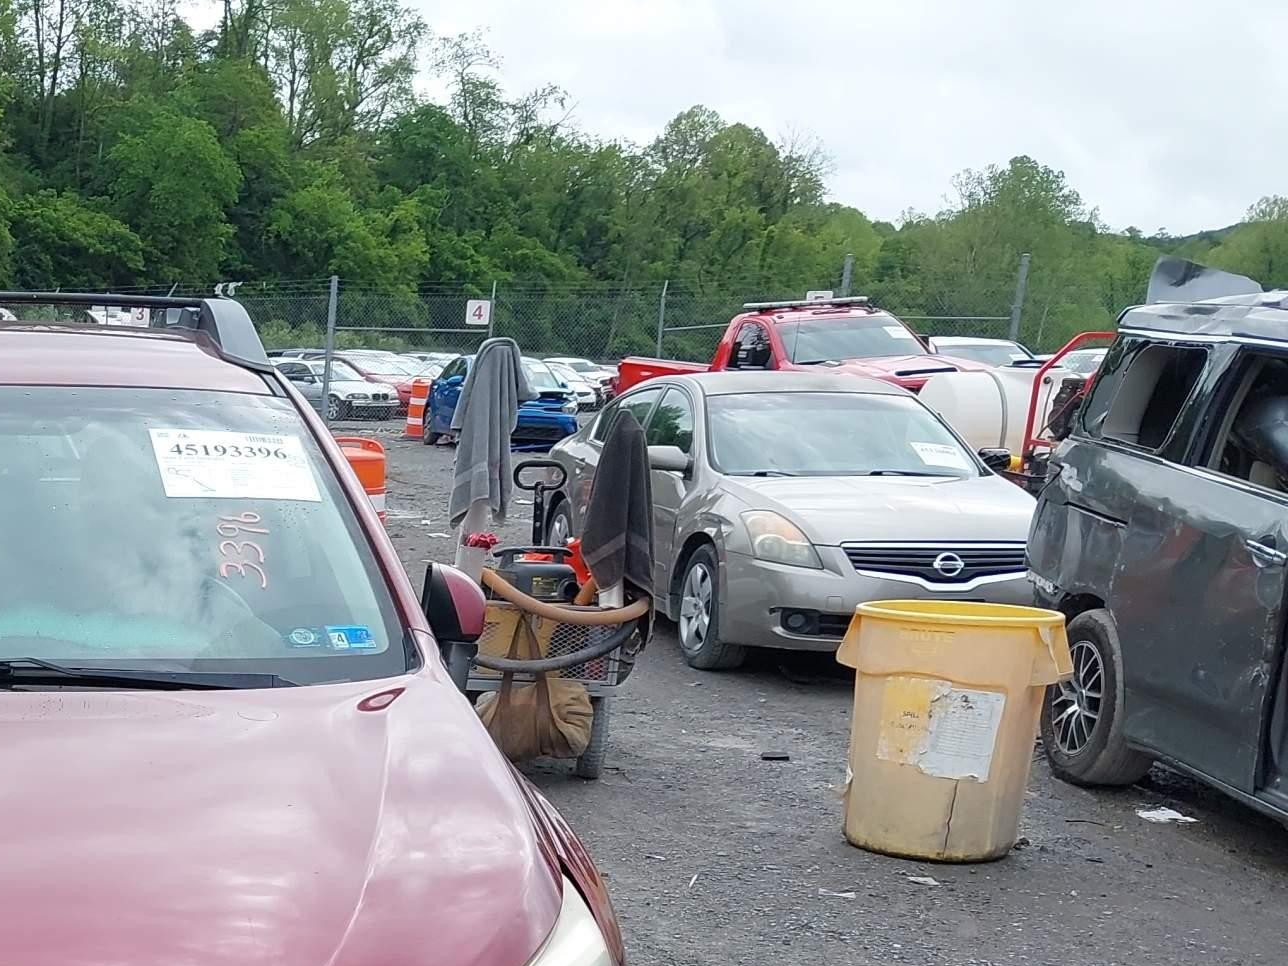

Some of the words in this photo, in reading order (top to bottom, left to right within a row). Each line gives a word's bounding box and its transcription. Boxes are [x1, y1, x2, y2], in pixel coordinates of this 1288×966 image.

[136, 307, 145, 321] 3
[472, 304, 484, 320] 4
[169, 443, 287, 460] 45193396
[216, 511, 270, 588] 3396
